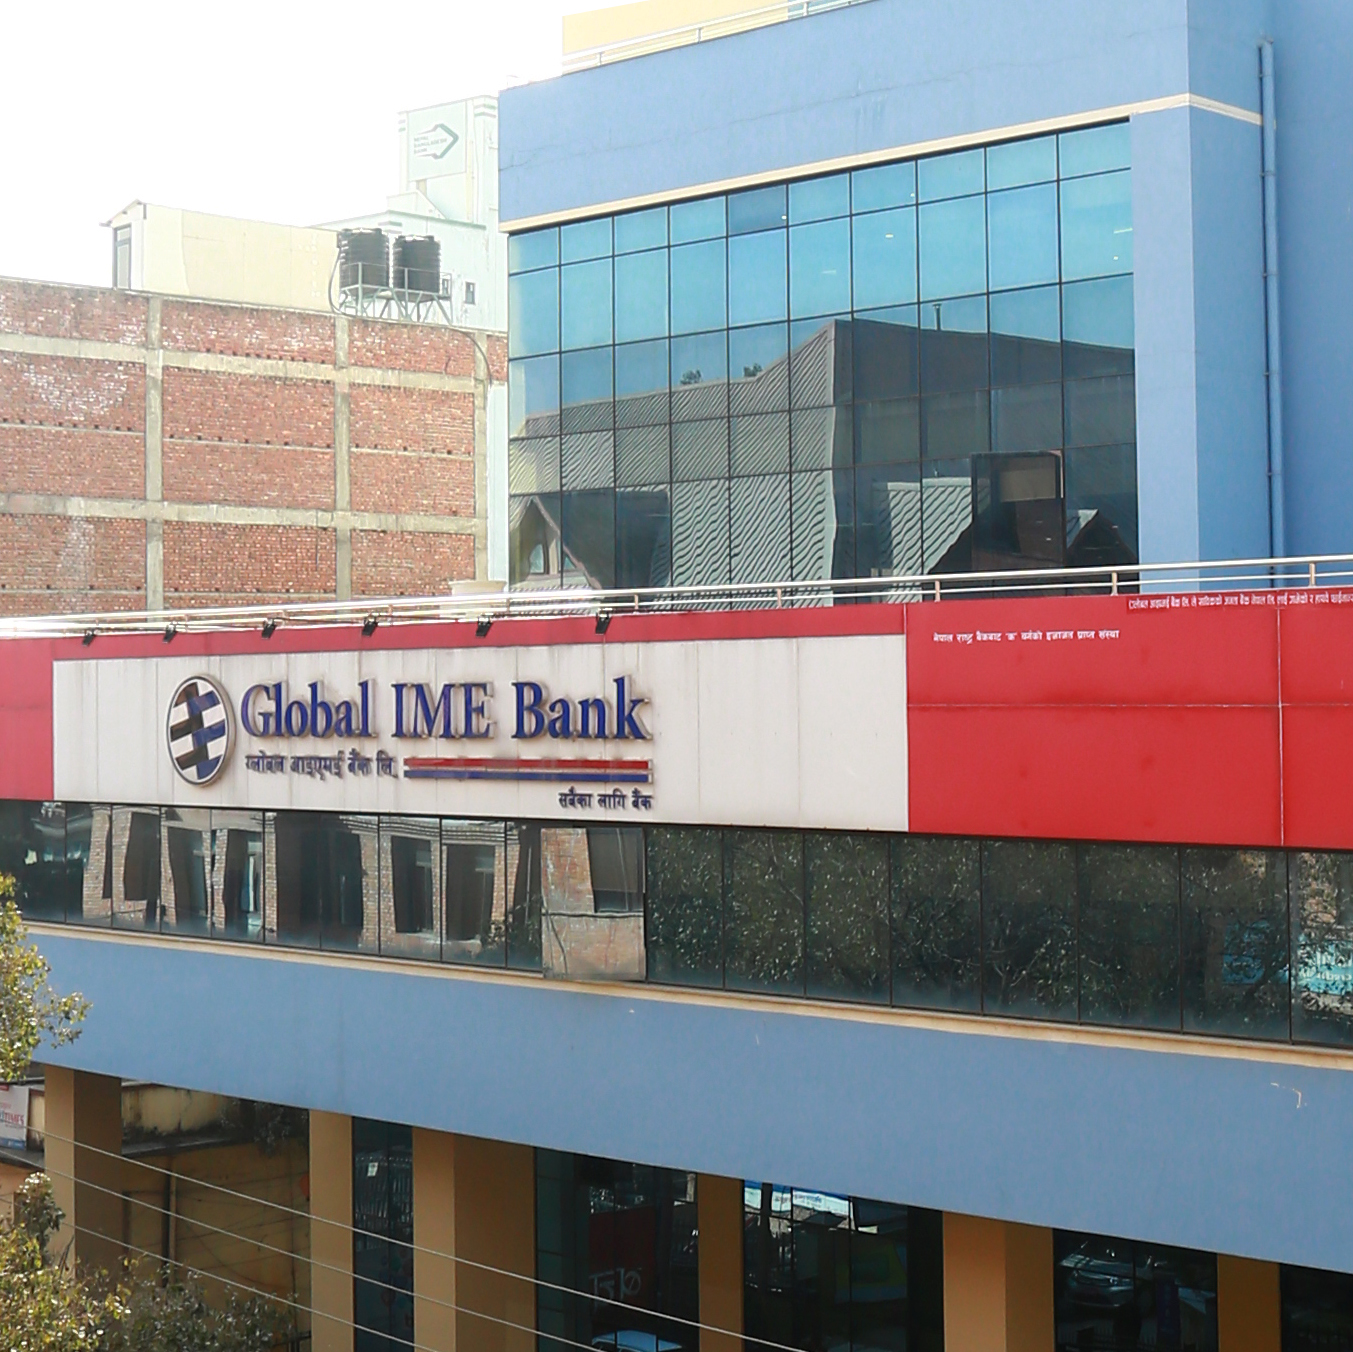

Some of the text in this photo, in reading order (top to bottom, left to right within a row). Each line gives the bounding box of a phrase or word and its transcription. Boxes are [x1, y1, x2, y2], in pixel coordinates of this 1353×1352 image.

[240, 674, 653, 740] Global IME Bank
[597, 788, 628, 809] लागि
[631, 787, 653, 809] बैंक
